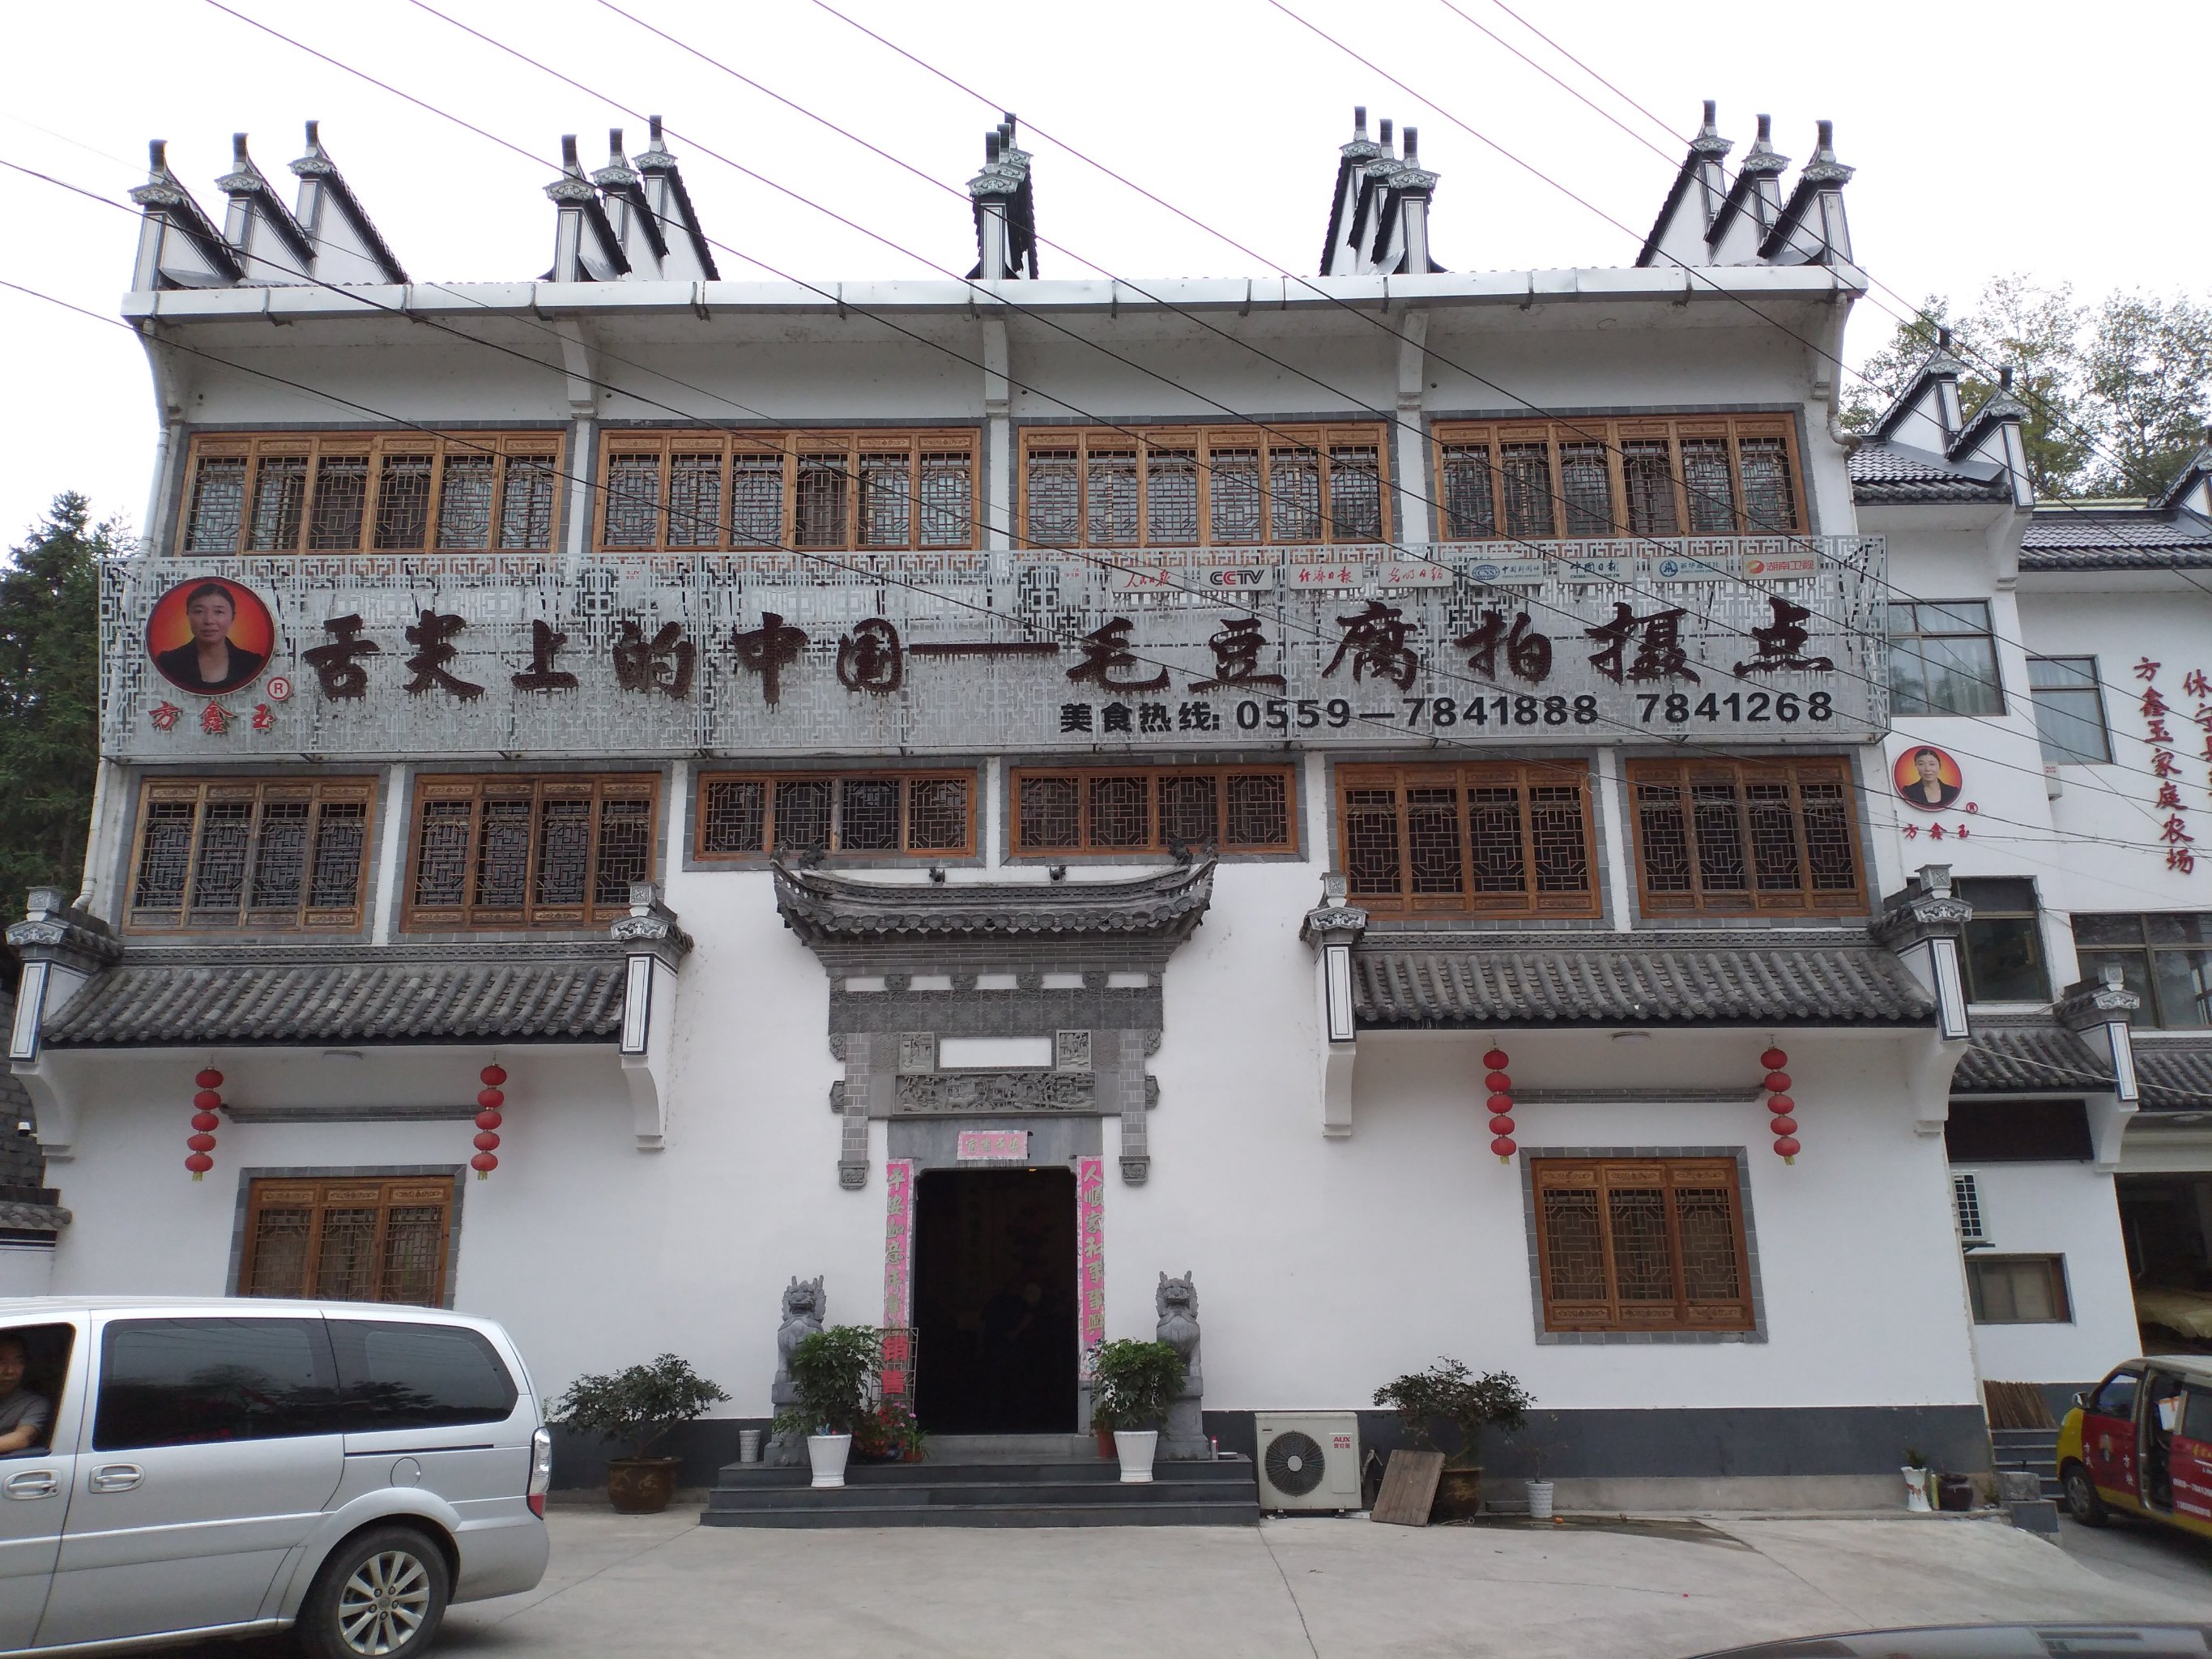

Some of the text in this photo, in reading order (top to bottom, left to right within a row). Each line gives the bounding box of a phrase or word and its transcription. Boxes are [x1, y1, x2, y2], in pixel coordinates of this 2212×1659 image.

[1210, 569, 1265, 585] CCTV
[1767, 560, 1814, 571] 湖南卫视
[148, 701, 278, 734] 方鑫玉
[1637, 691, 1833, 723] 7841268
[2133, 656, 2194, 874] 方鑫玉家庭农场
[1903, 821, 1970, 841] 方鑫玉
